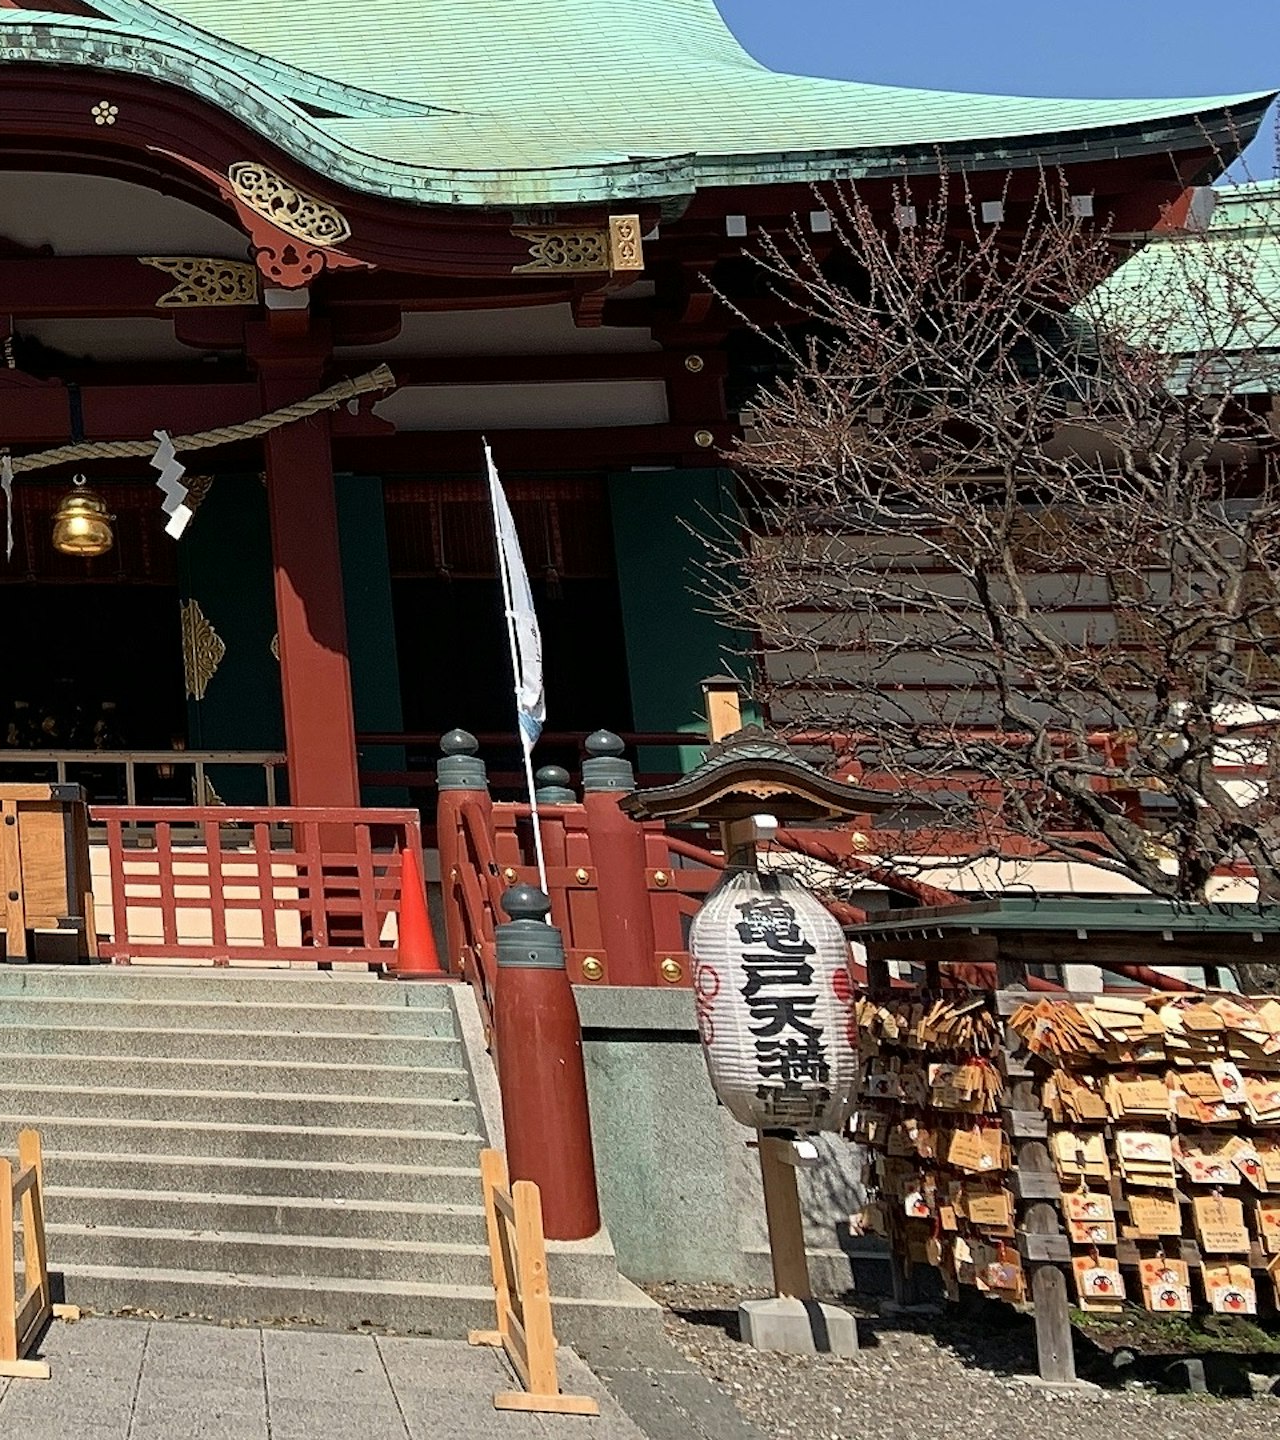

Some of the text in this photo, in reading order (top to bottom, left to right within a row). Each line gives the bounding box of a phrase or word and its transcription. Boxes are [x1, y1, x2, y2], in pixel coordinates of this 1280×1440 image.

[734, 896, 831, 1126] 亀戸天満宮
